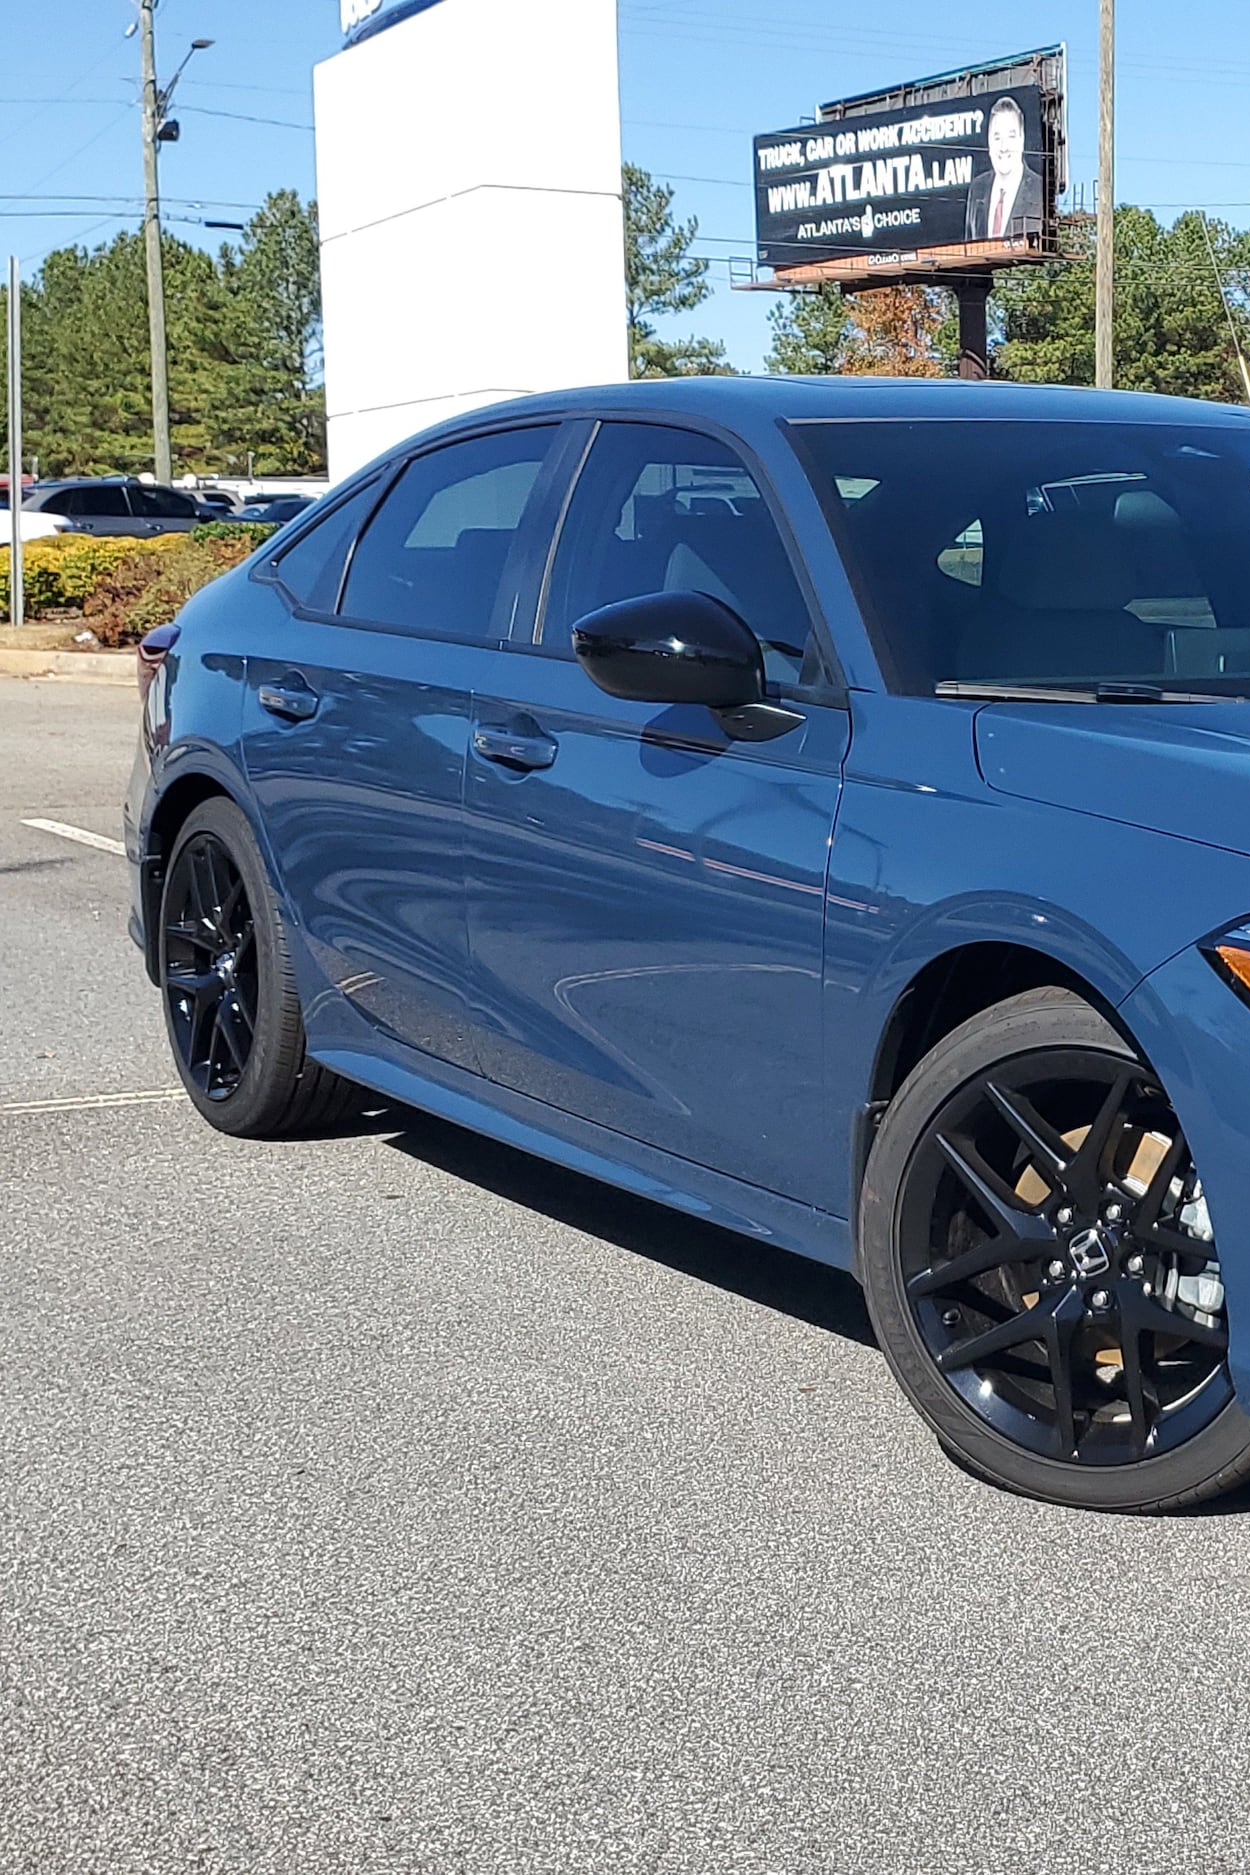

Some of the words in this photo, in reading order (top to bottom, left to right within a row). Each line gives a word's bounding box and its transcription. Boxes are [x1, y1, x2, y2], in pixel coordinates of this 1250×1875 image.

[758, 141, 805, 170] TRUCK,
[806, 136, 834, 161] CAR
[835, 131, 856, 156] OR
[857, 124, 899, 152] WORK
[900, 109, 984, 145] ACCIDENT?
[797, 216, 861, 239] ATLANTA'S
[874, 208, 921, 228] CHOICE
